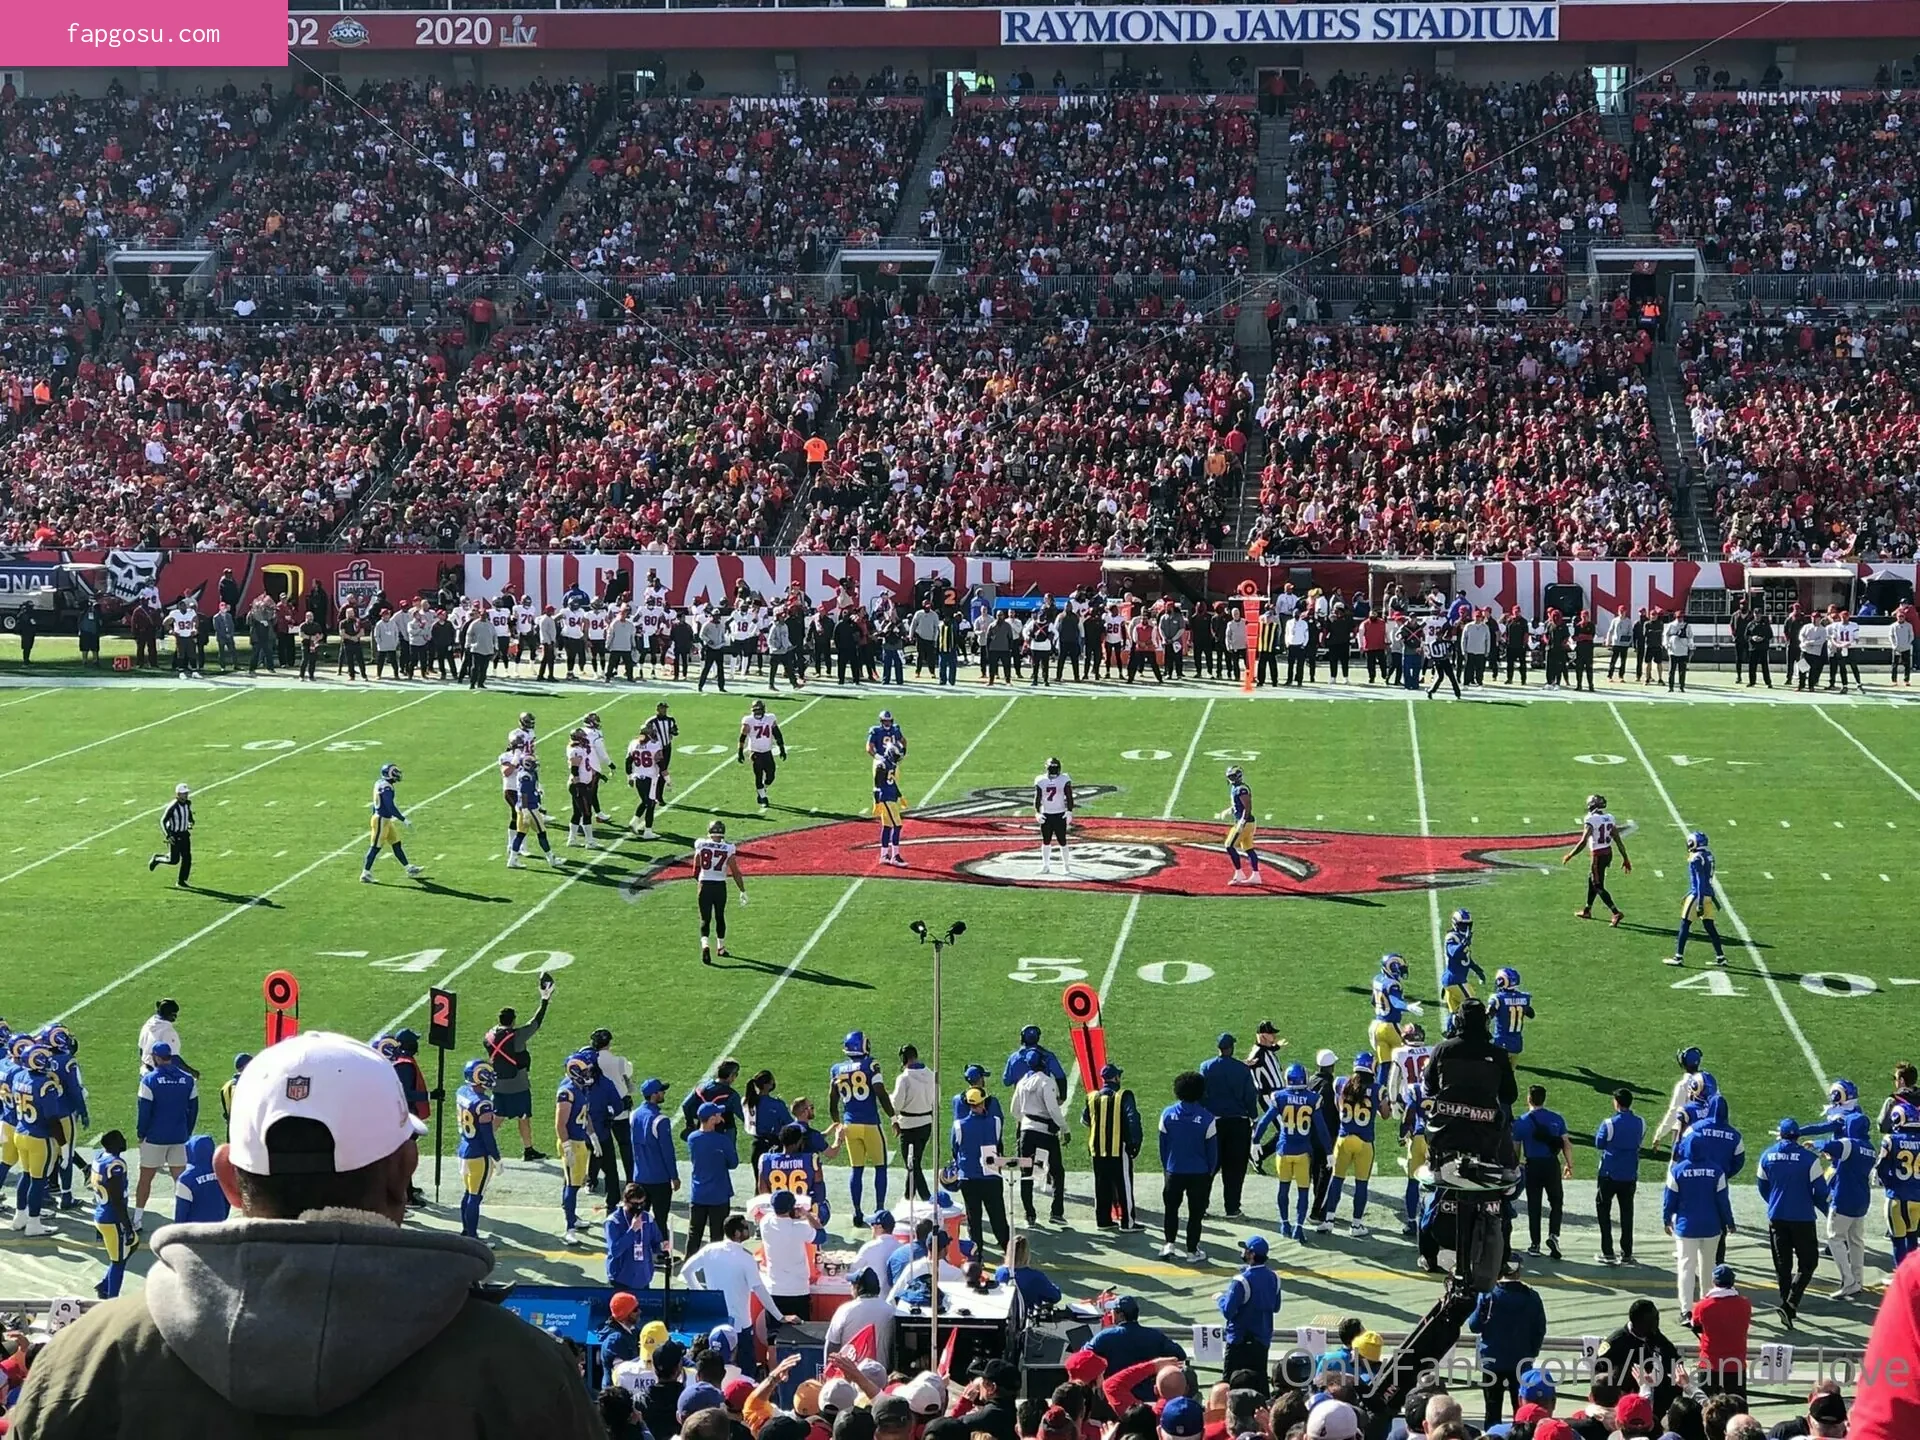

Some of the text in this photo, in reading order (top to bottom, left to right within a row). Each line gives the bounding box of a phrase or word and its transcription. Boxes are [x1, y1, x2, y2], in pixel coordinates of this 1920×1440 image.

[415, 17, 492, 45] 2020
[1004, 6, 1556, 42] RAYMOND JAMES STADIUM
[944, 590, 956, 605] 2
[737, 622, 748, 632] 18
[1107, 624, 1119, 634] 26
[753, 726, 771, 740] 74
[632, 750, 652, 768] 66
[1045, 786, 1057, 802] 7
[699, 848, 729, 872] 87
[1008, 956, 1215, 985] 50
[433, 994, 450, 1028] 2
[1508, 1006, 1524, 1033] 11
[288, 1086, 309, 1098] NFL
[834, 1070, 870, 1104] 58
[1287, 1095, 1308, 1105] HALEY
[1281, 1105, 1314, 1136] 46
[771, 1160, 804, 1169] BLANTON
[768, 1169, 809, 1196] 86
[545, 1319, 570, 1327] Surface
[546, 1313, 577, 1321] Microsoft
[1212, 1327, 1221, 1339] G
